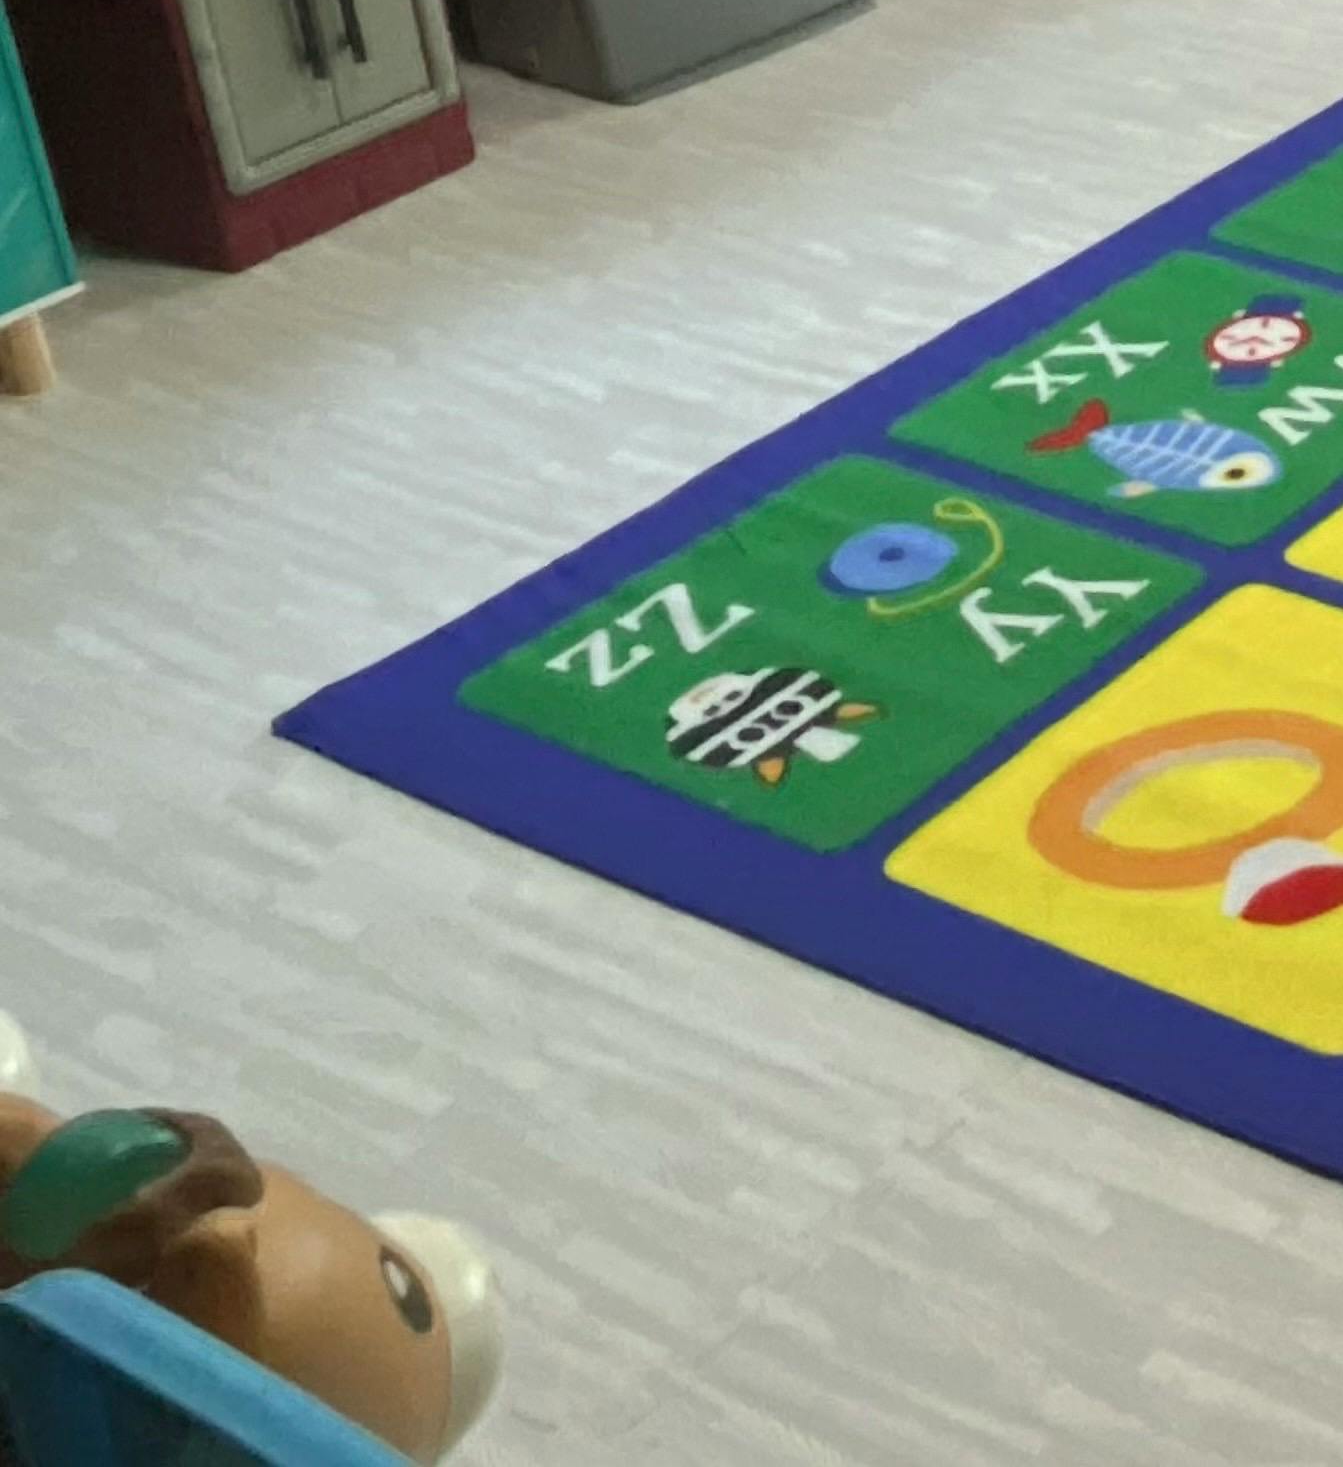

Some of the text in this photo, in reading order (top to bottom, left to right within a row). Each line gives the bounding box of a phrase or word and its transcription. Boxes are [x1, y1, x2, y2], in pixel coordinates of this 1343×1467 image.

[990, 320, 1170, 404] Xx
[545, 582, 756, 688] Zz
[958, 567, 1150, 664] Yy
